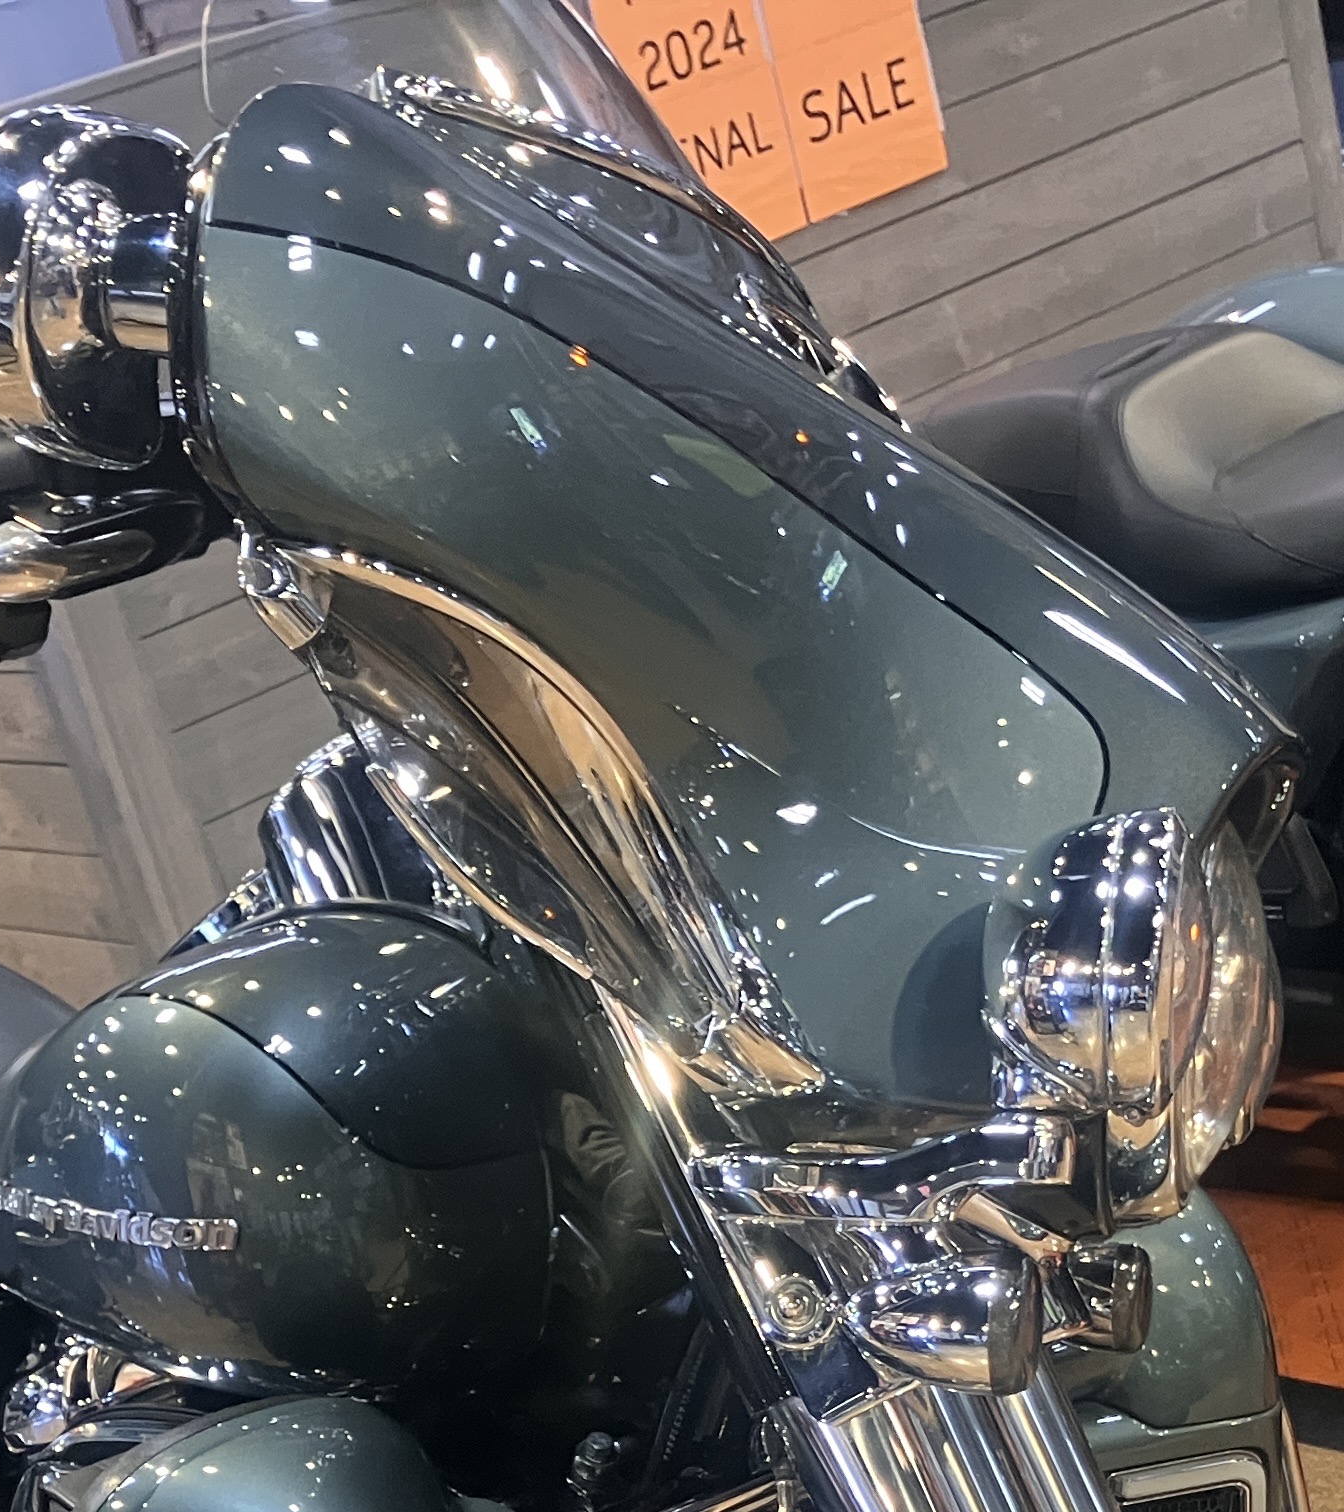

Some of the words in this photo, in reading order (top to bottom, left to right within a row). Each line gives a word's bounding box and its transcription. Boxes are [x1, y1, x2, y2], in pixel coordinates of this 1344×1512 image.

[638, 9, 747, 91] 2024
[680, 111, 774, 178] NAL
[802, 57, 916, 144] SALE
